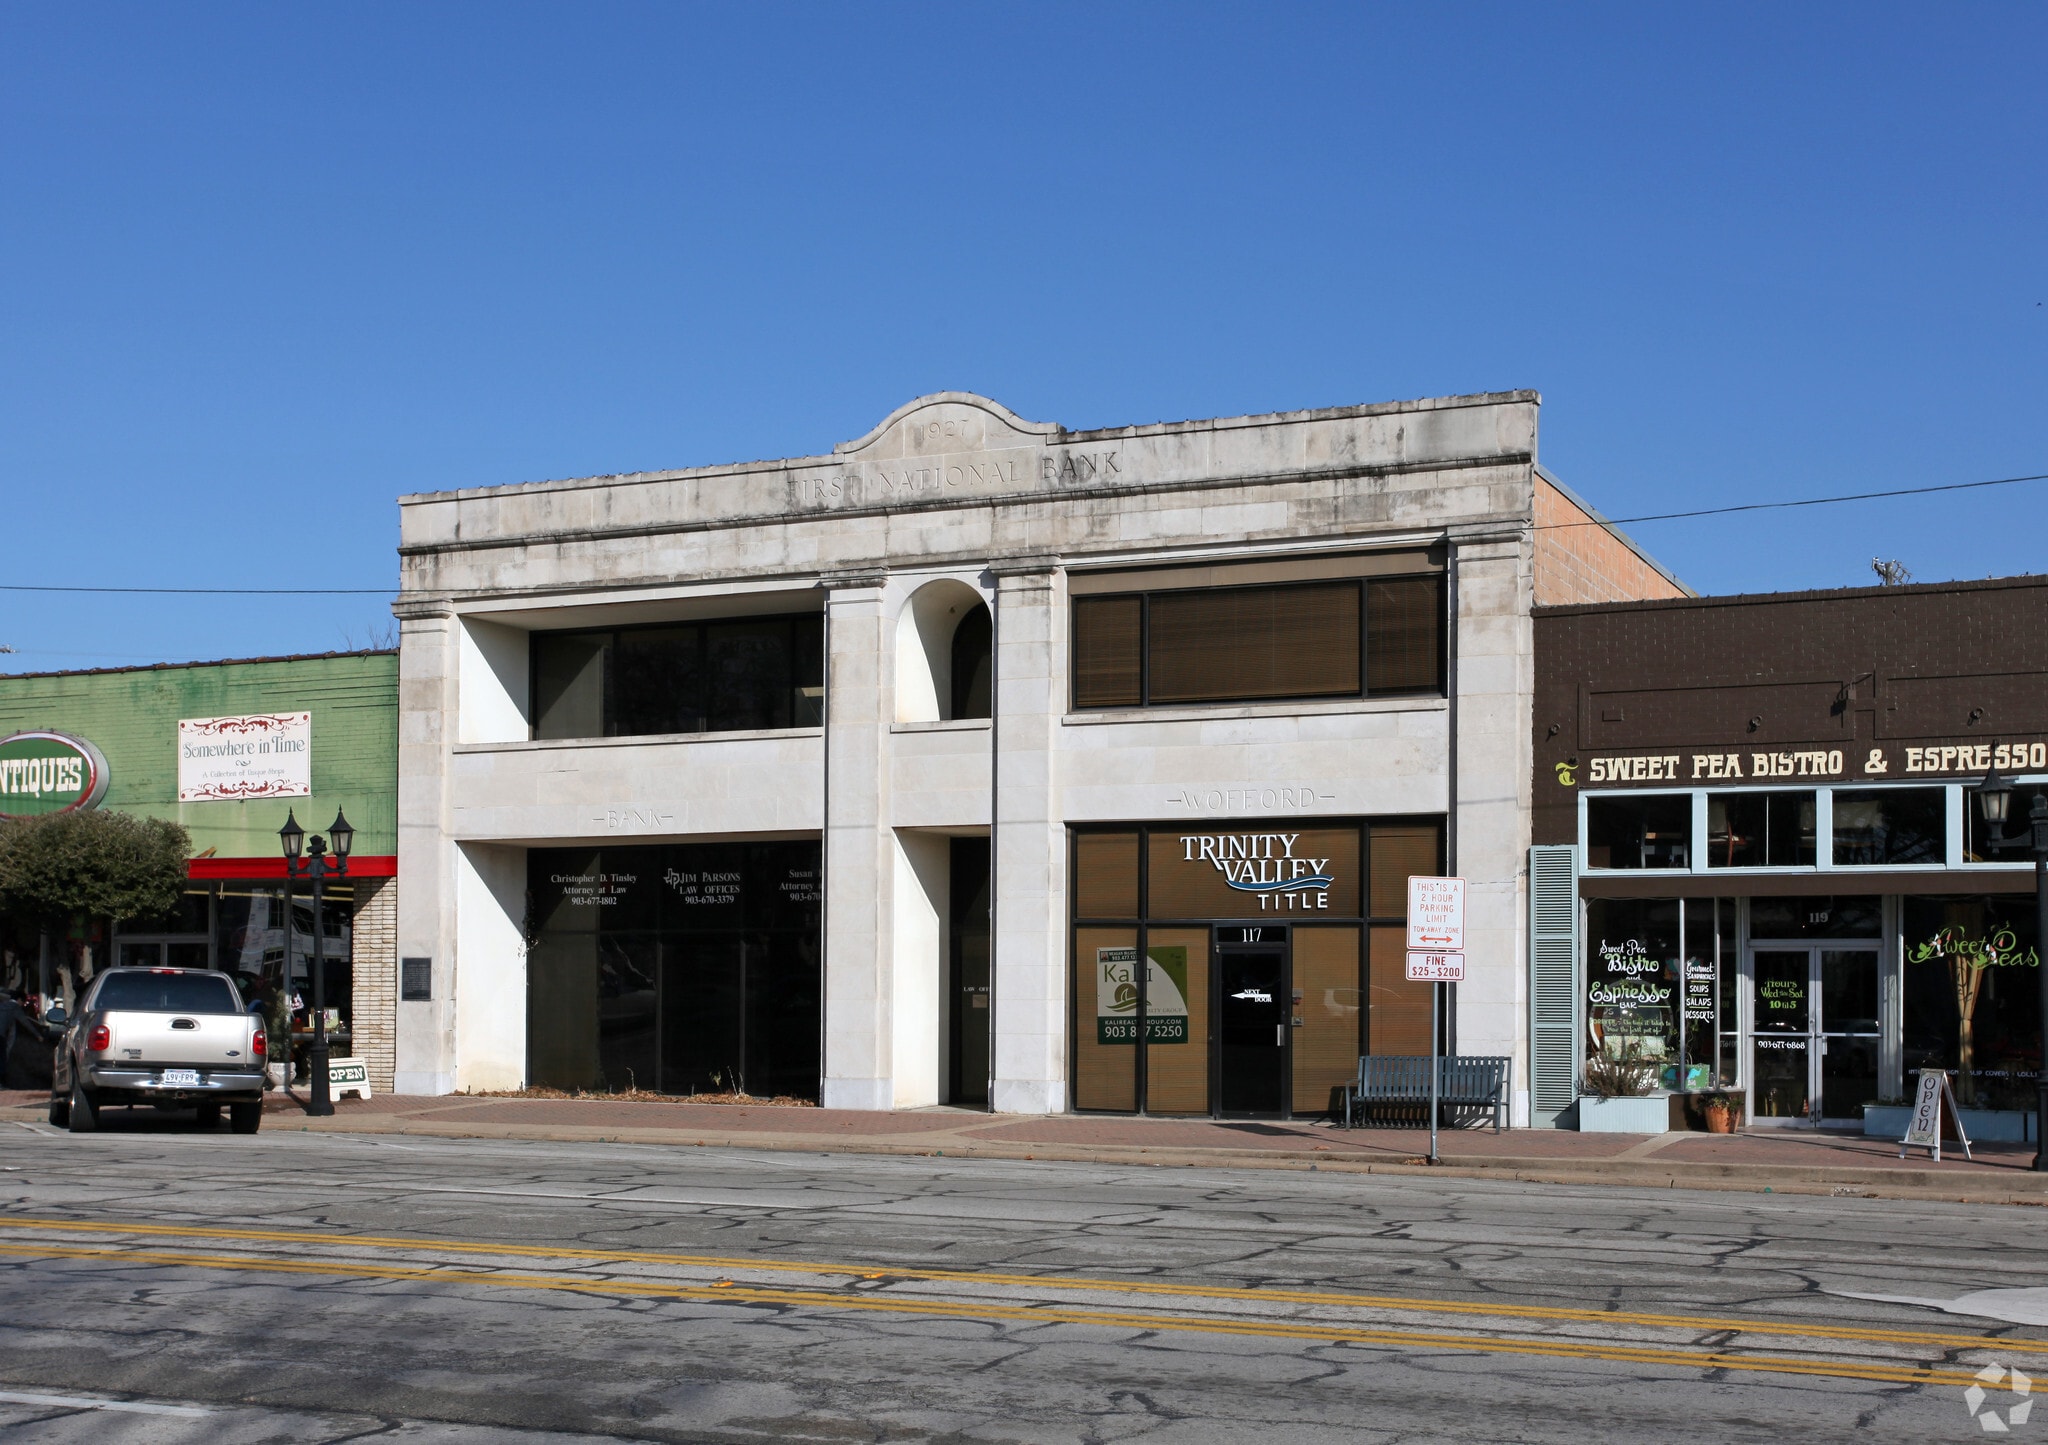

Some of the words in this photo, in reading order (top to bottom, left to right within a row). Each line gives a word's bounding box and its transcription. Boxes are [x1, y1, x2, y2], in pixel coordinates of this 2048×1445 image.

[918, 420, 968, 440] 1927
[787, 475, 860, 500] FIRST
[879, 461, 1020, 494] NATIONAL
[1042, 451, 1121, 479] BANK
[183, 740, 255, 758] Somewhere
[259, 738, 270, 759] in
[1590, 755, 1680, 782] SWEET
[1692, 753, 1744, 779] PEA
[1751, 750, 1843, 777] BISTRO
[1864, 749, 1888, 774] &
[1906, 743, 2047, 772] ESPRESSO
[0, 757, 82, 798] NTIQUES
[1181, 787, 1315, 811] WOFFORD
[606, 809, 662, 828] BANK
[1179, 833, 1300, 870] TRINITY
[680, 872, 697, 884] JIM
[702, 871, 741, 882] PARSONS
[1220, 858, 1330, 884] VALLEY
[550, 874, 596, 885] Christopher
[599, 873, 608, 883] D.
[610, 873, 637, 884] Tinsley
[562, 885, 595, 896] Attorney
[598, 886, 606, 895] at
[611, 885, 627, 895] Law
[679, 885, 698, 895] LAW
[704, 885, 741, 894] OFFICES
[1416, 883, 1435, 892] THIS
[1439, 884, 1448, 892] IS
[684, 895, 735, 904] 903-670-3379
[1257, 892, 1329, 911] TITLE
[1421, 894, 1427, 902] 2
[1431, 894, 1454, 903] HOUR
[1419, 904, 1455, 913] PARKING
[1426, 915, 1448, 923] LIMIT
[1809, 912, 1829, 923] 119
[1242, 927, 1262, 943] 117
[1599, 939, 1625, 956] Sweet
[1626, 939, 1647, 956] Pea
[1425, 956, 1447, 966] FINE
[1604, 953, 1660, 975] Bistro
[1589, 981, 1672, 1004] Espresso
[1689, 985, 1709, 993] SOUPS
[1686, 998, 1712, 1007] SALADS
[1769, 1001, 1781, 1009] 10
[1789, 1001, 1797, 1009] 5
[1685, 1010, 1715, 1023] DESSERTS
[1104, 1026, 1126, 1038] 903
[1129, 1026, 1152, 1038] 87
[1154, 1025, 1183, 1037] 5250
[329, 1067, 363, 1080] OPEN
[1918, 1077, 1937, 1132] OPEN
